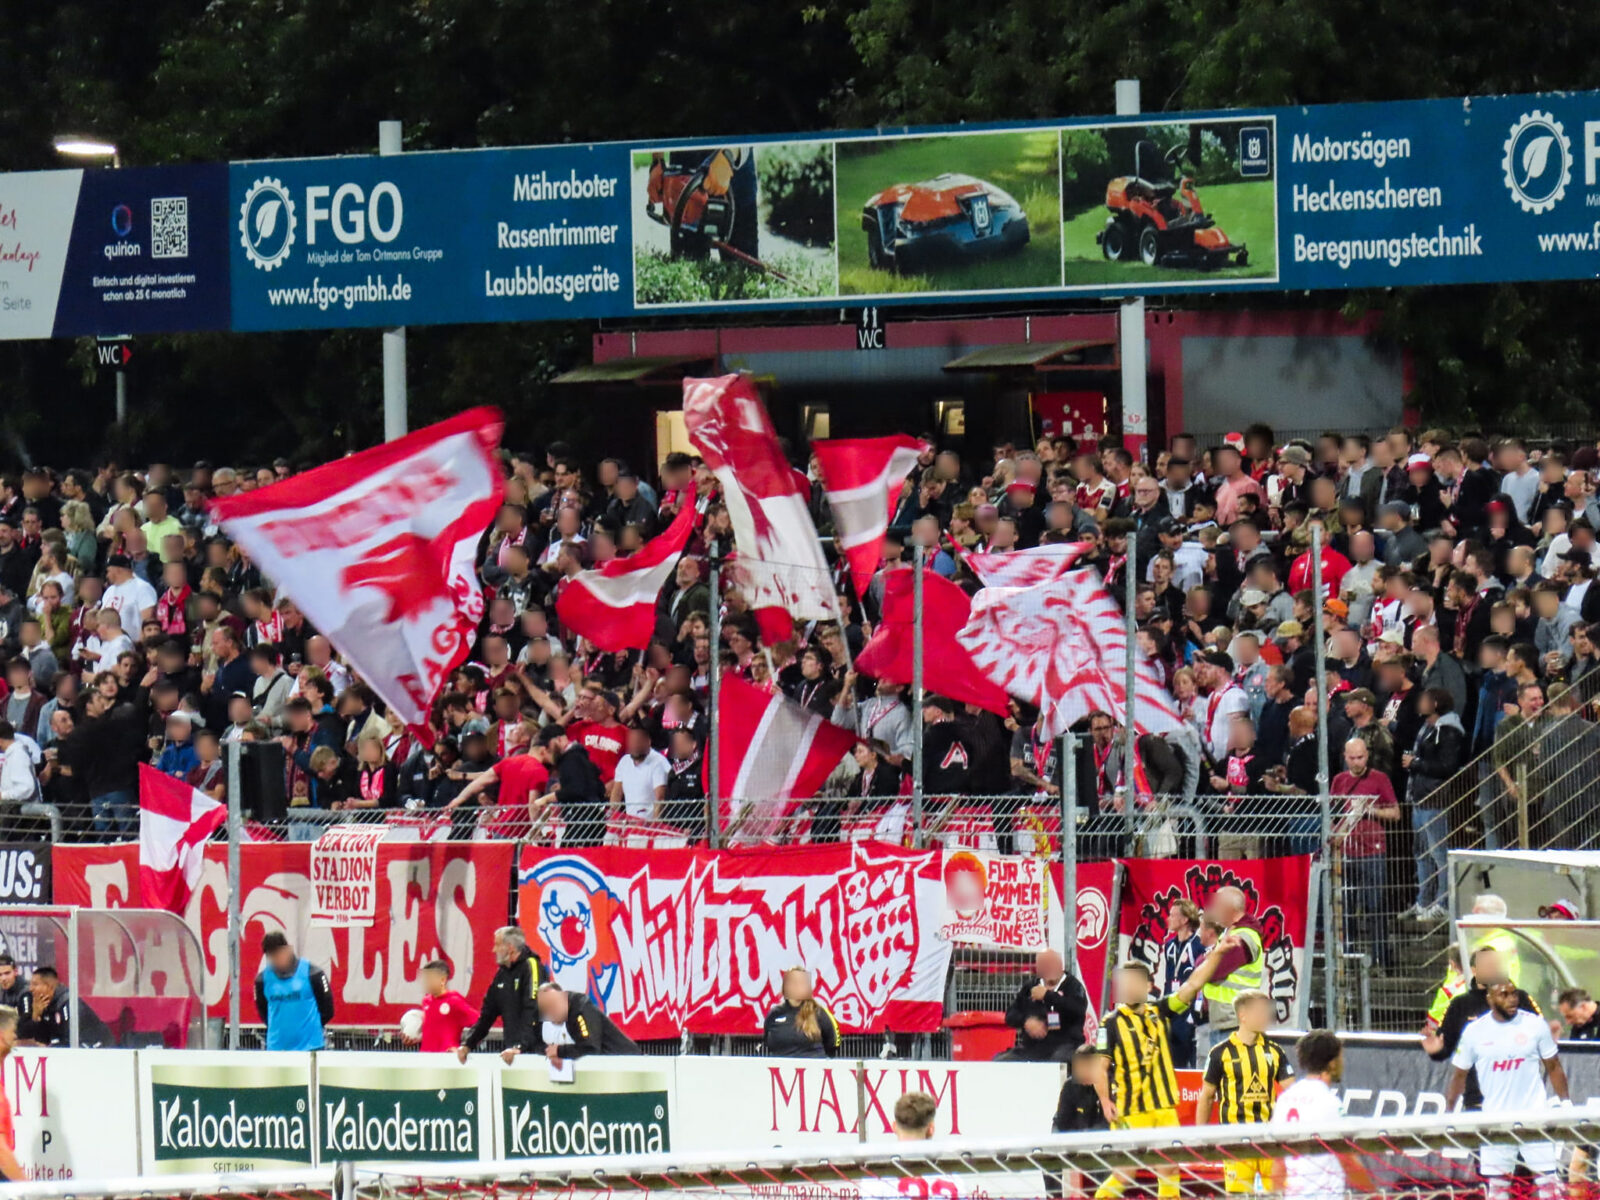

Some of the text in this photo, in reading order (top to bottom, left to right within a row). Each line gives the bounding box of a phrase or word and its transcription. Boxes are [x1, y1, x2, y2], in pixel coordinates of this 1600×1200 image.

[1292, 132, 1411, 168] Motorsägen
[513, 169, 618, 202] Mähroboter
[1293, 177, 1442, 213] Heckenscheren
[306, 181, 404, 245] FGO
[498, 219, 619, 249] Rasentrimmer
[1294, 224, 1483, 269] Beregnungstechnik
[104, 241, 141, 260] quirion
[307, 250, 339, 268] Mitglied
[340, 248, 354, 263] der
[373, 248, 412, 262] Ortmanns
[412, 246, 444, 262] Gruppe
[268, 273, 412, 311] www.fgo-gmbh.de
[485, 265, 620, 302] Laubblasgeräte
[3, 297, 32, 311] Seite
[859, 329, 883, 348] WC
[98, 345, 120, 364] WC
[314, 856, 374, 882] STADION
[315, 885, 370, 911] VERBOT
[993, 921, 1023, 946] UNS
[1493, 1058, 1525, 1072] HIT
